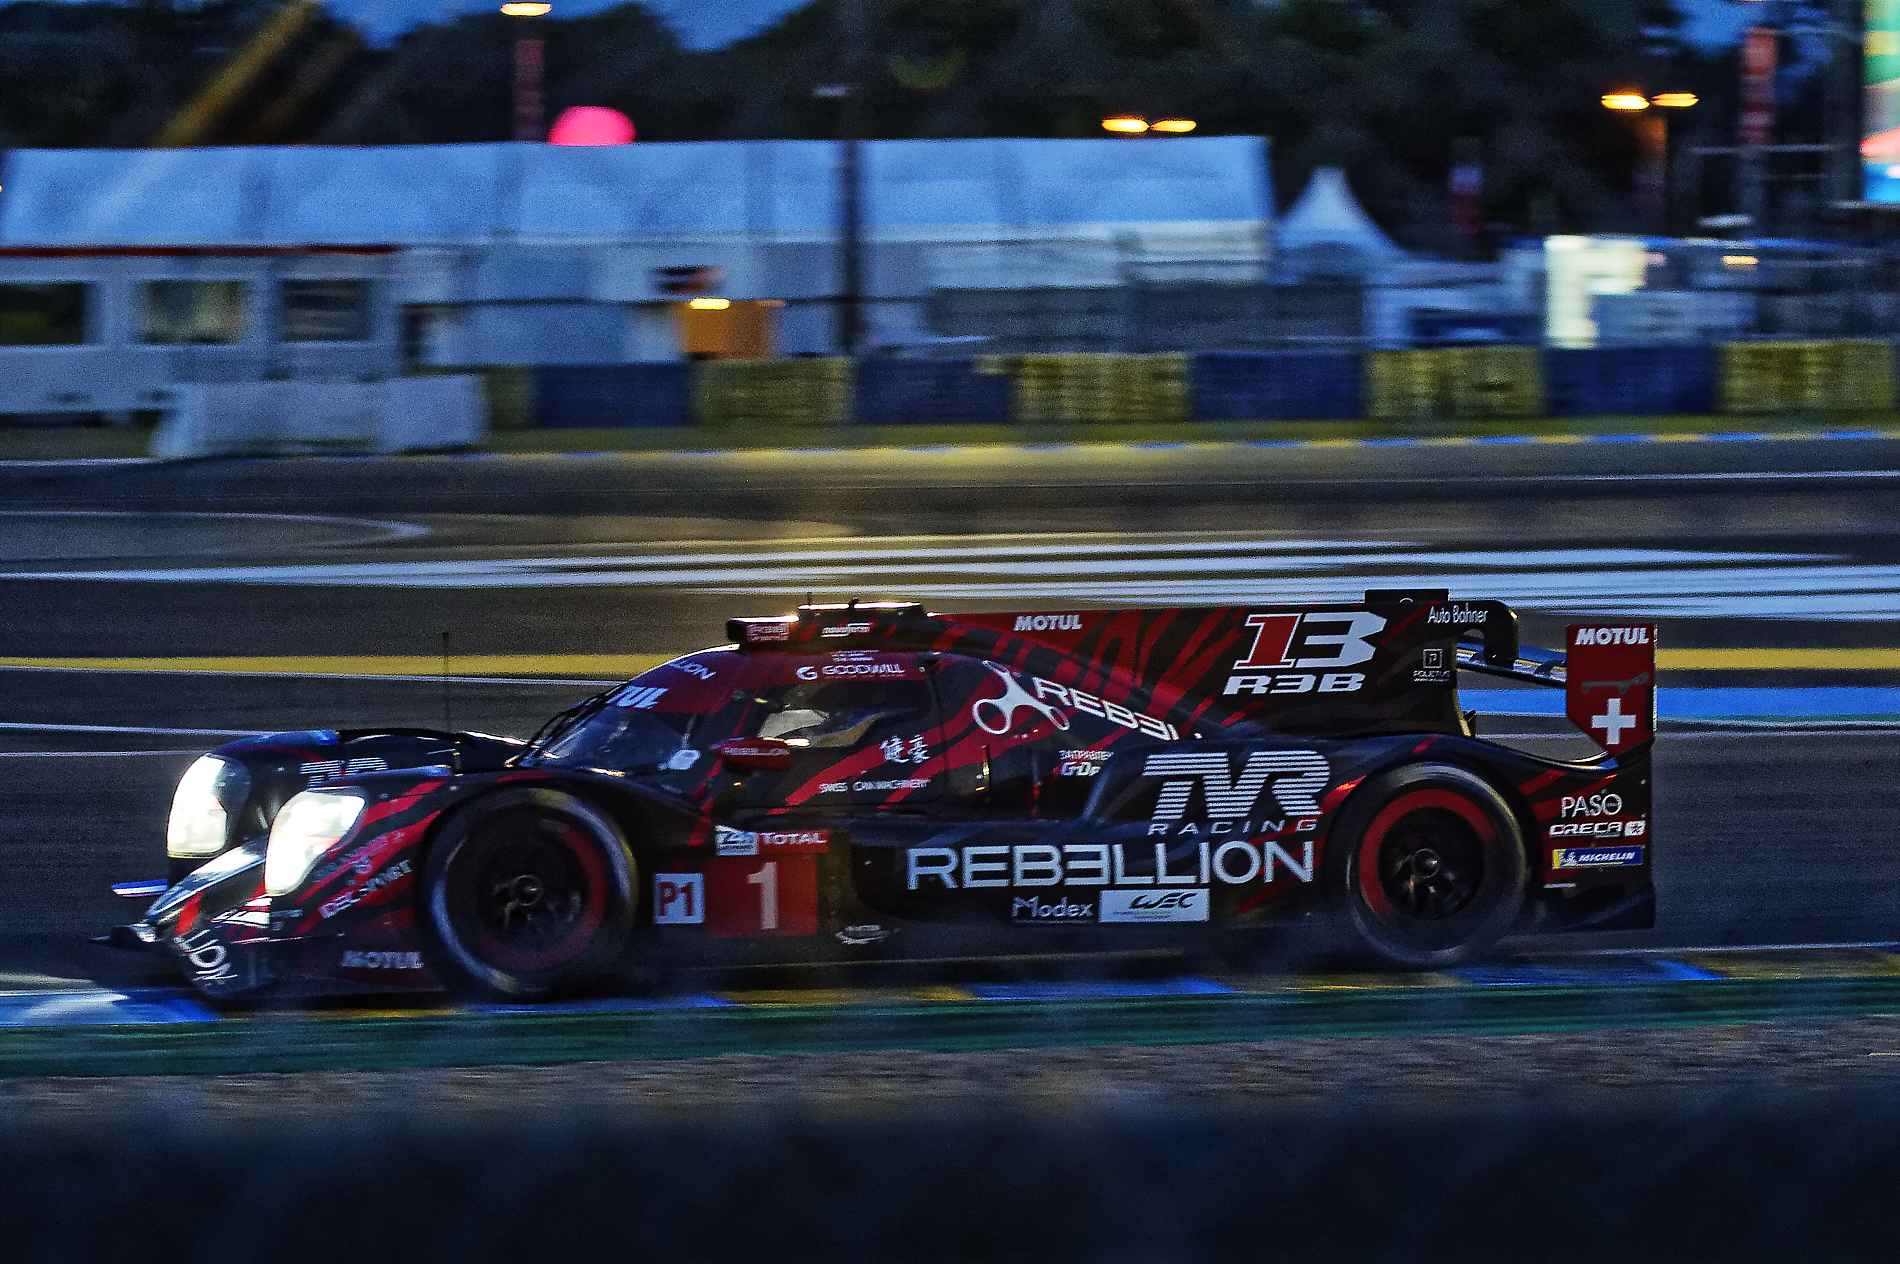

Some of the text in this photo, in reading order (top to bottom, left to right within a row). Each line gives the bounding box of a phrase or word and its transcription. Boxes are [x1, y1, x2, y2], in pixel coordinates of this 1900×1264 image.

[1014, 614, 1082, 631] MOTUL
[1427, 605, 1450, 624] Auto
[1574, 627, 1649, 646] MOTUL
[822, 663, 905, 675] GOODWILL
[1142, 750, 1331, 820] TVR
[1561, 793, 1623, 818] PASO
[1147, 819, 1318, 836] RACING
[760, 832, 828, 845] TOTAL
[906, 840, 1315, 890] REBELLION
[1578, 851, 1636, 862] MICHELIN
[656, 880, 697, 918] P1
[746, 862, 780, 930] 1
[1129, 891, 1199, 910] WEC
